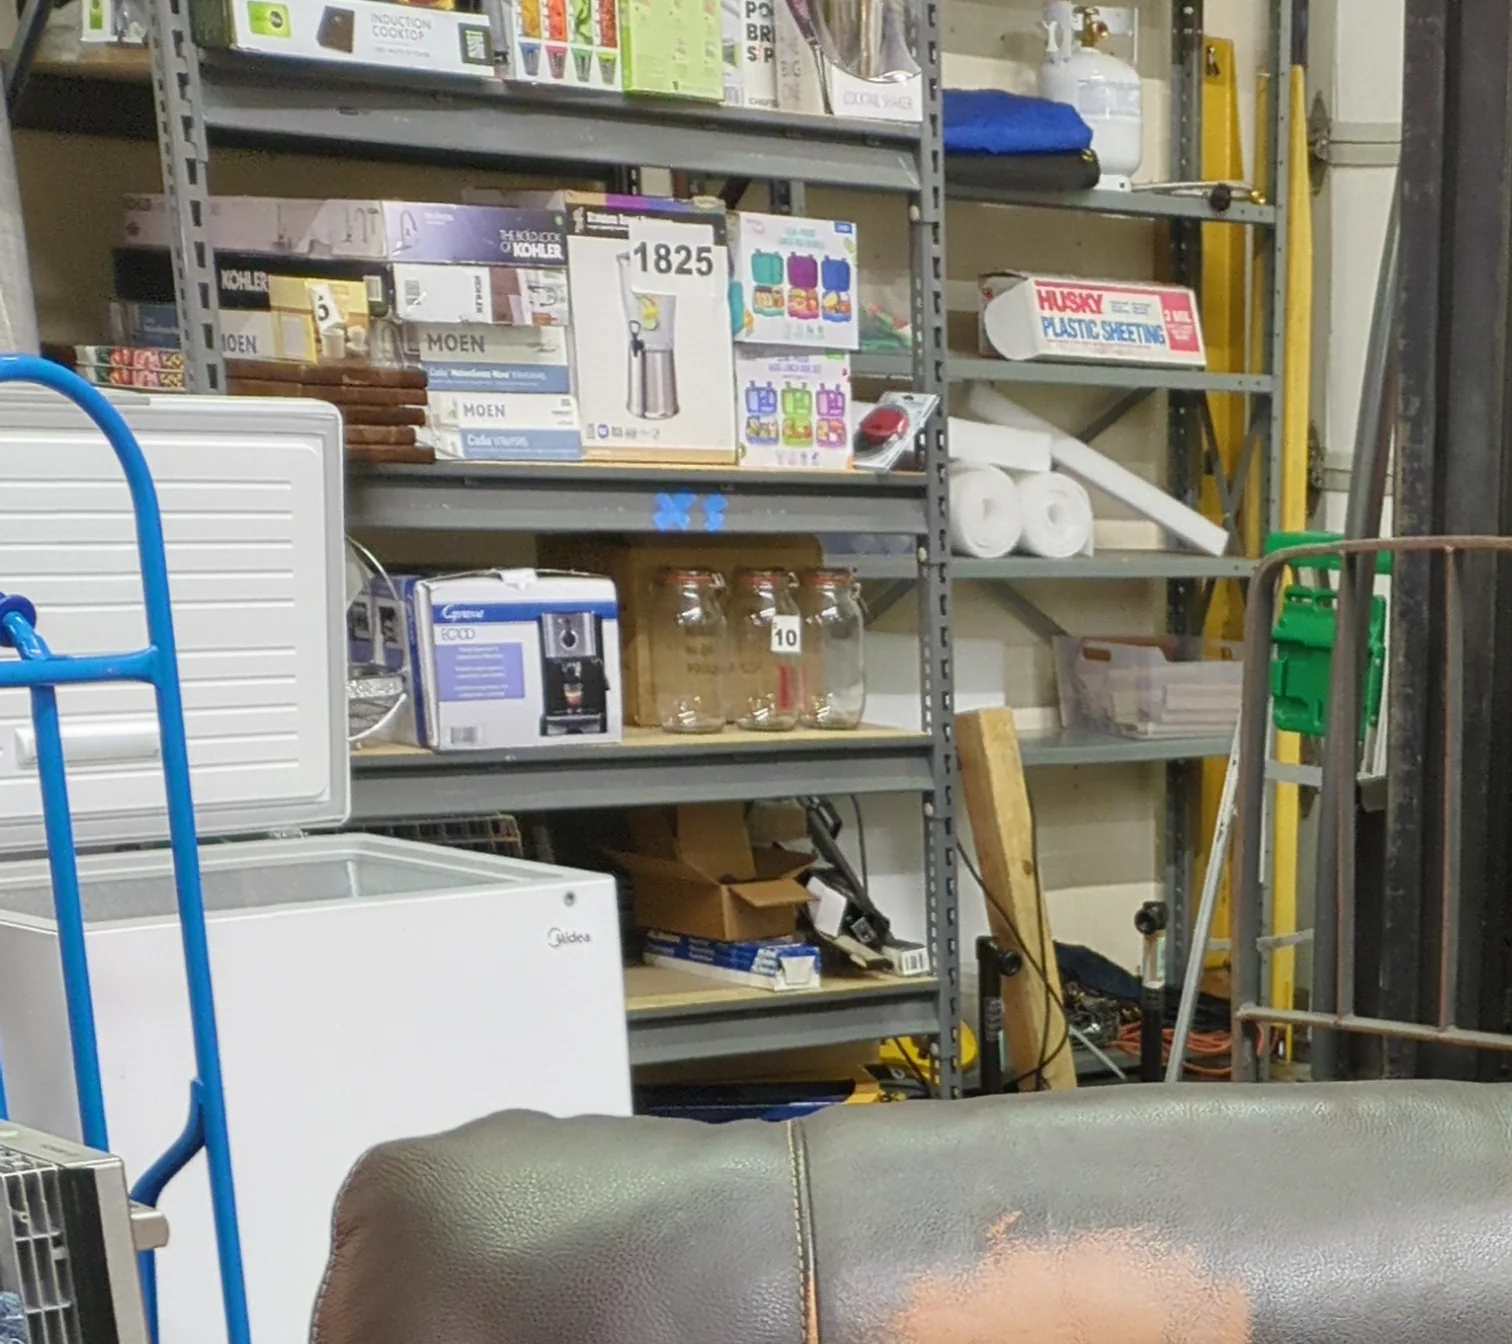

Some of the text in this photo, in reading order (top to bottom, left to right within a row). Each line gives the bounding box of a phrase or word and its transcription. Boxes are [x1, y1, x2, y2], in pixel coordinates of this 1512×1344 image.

[370, 13, 431, 29] INDUCTION
[372, 25, 424, 40] COOKTOP
[499, 230, 514, 241] THE
[513, 243, 564, 260] KOHLER
[633, 242, 713, 276] 1825
[221, 269, 269, 292] KOHLER
[1036, 289, 1105, 315] HUSKY
[1041, 316, 1100, 340] PLASTIC
[1102, 319, 1166, 345] SHEETING
[427, 333, 485, 353] MOEN
[463, 404, 506, 418] MOEN
[774, 629, 797, 647] 10
